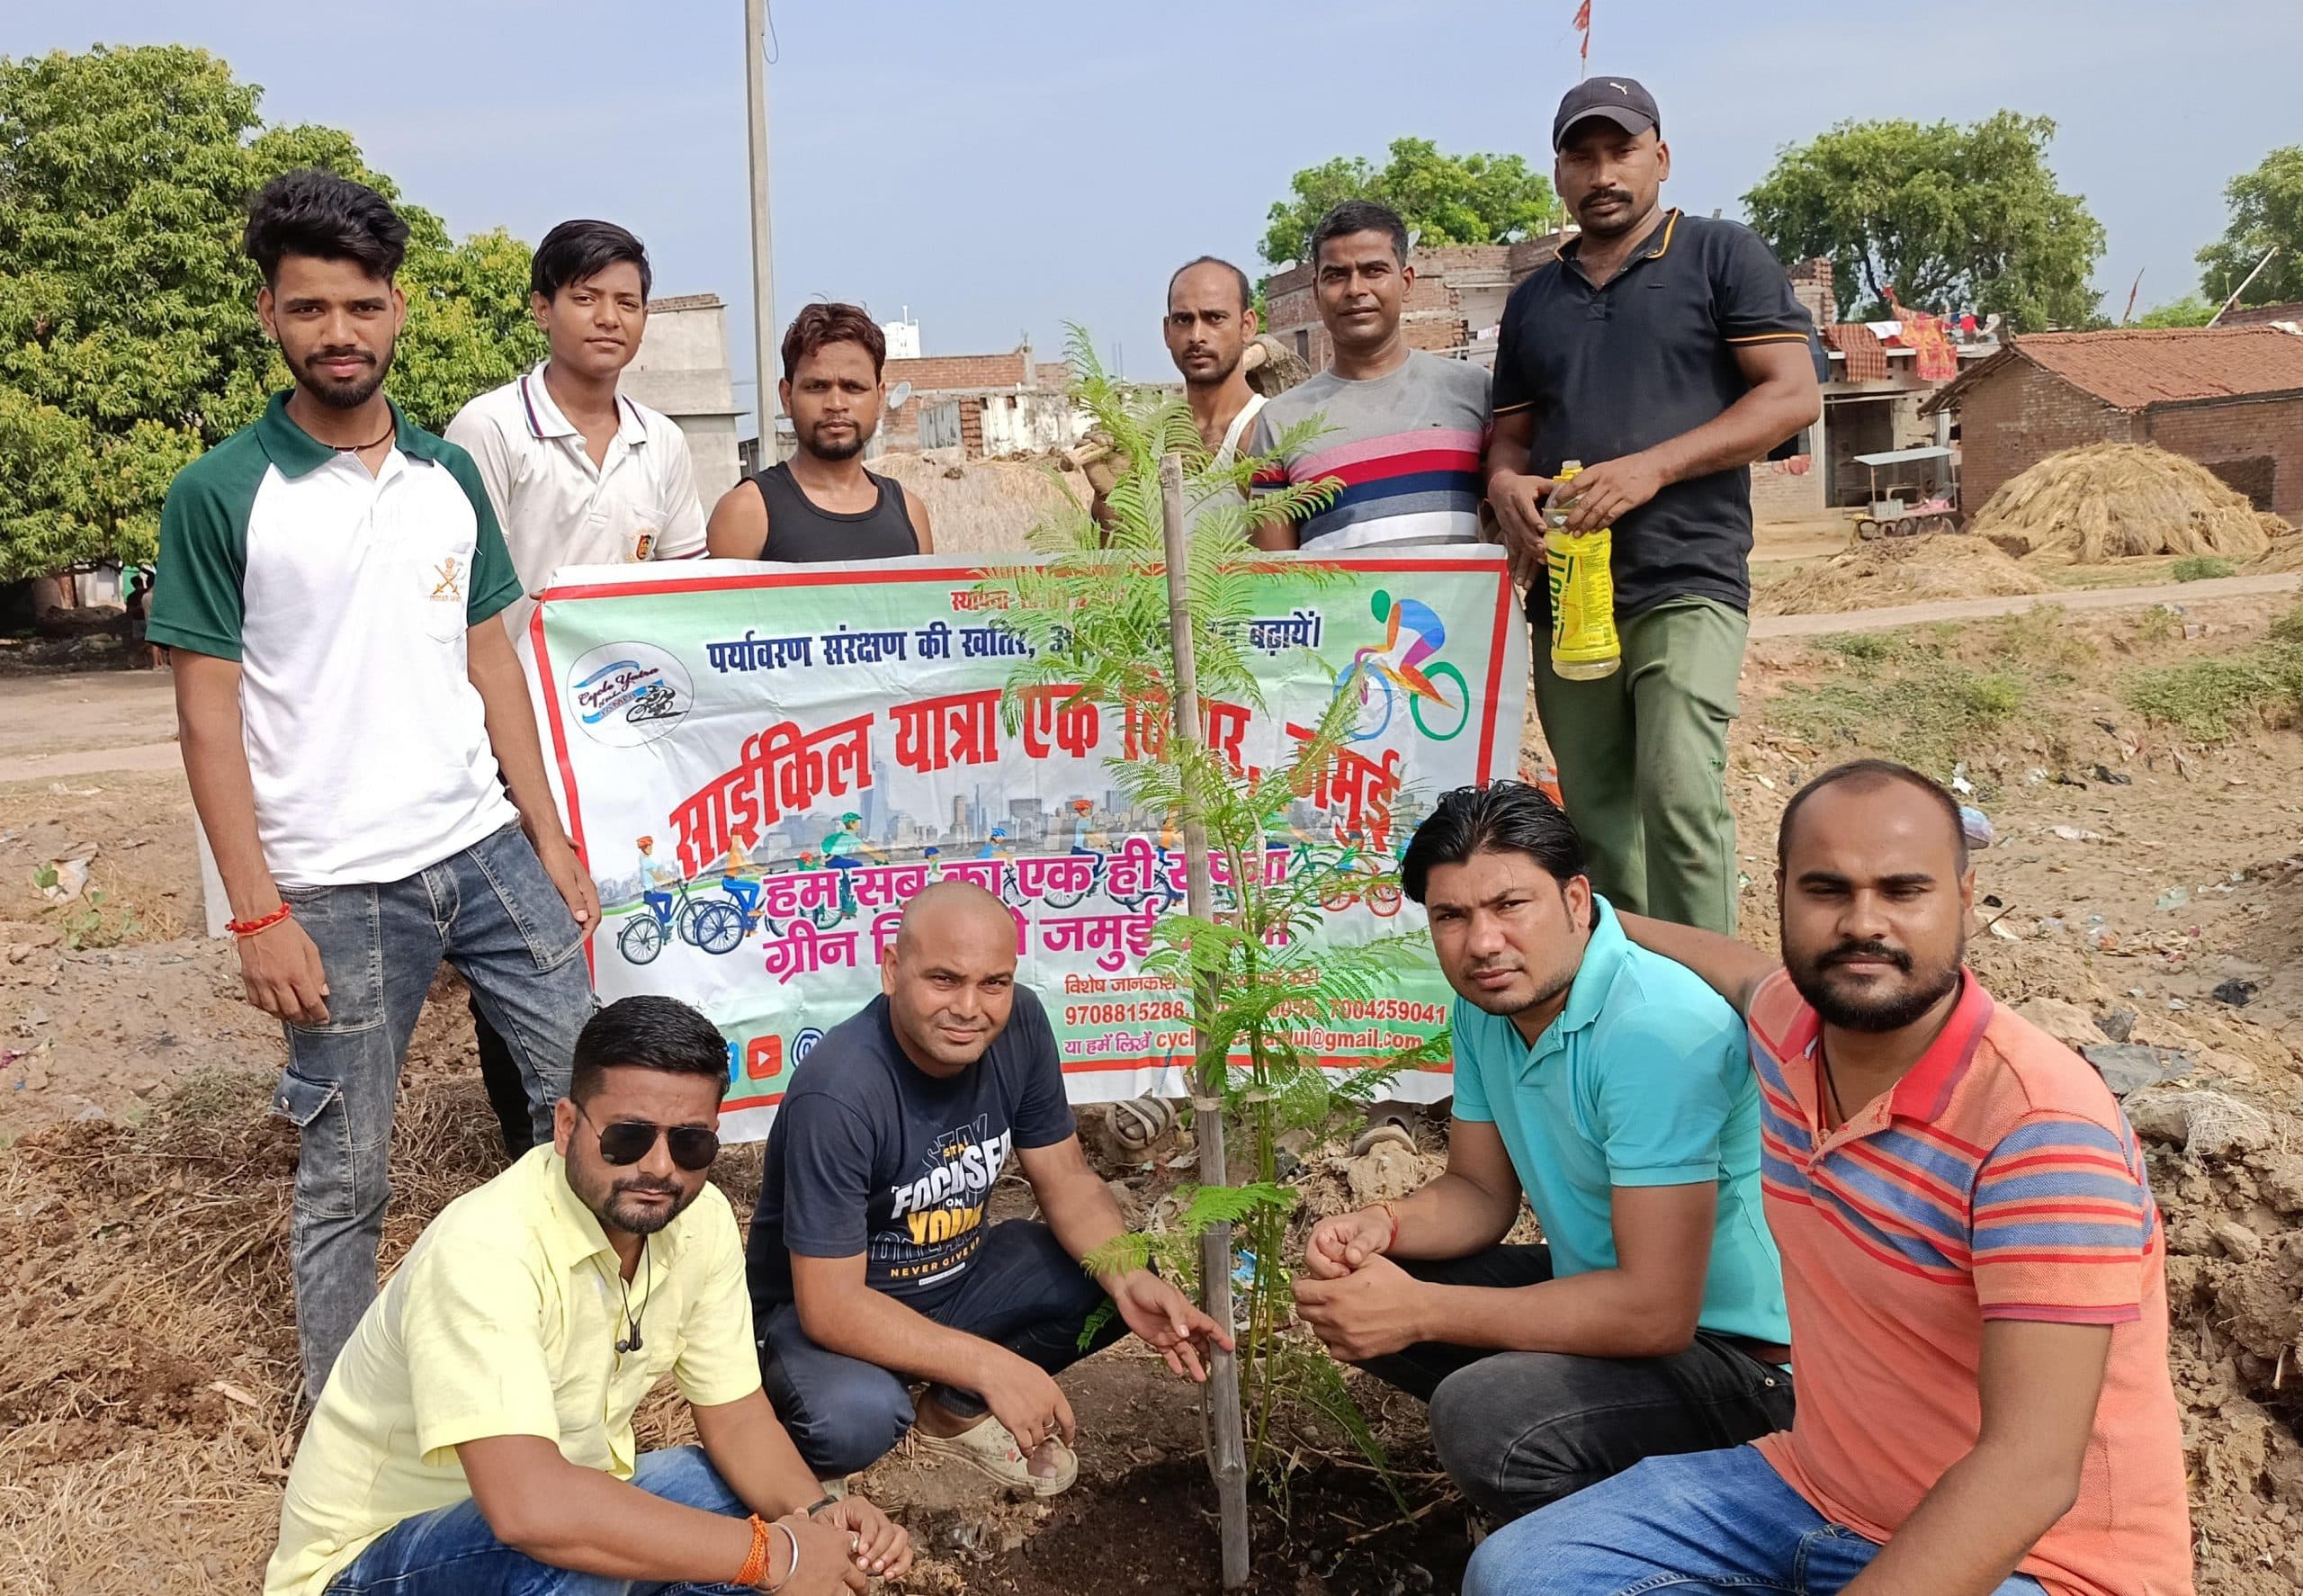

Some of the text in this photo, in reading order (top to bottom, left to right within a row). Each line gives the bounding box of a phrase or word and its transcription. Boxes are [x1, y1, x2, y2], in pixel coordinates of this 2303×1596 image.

[706, 631, 812, 673] पर्यावरण
[820, 625, 907, 665] संरक्षण
[916, 621, 952, 659] की
[669, 713, 874, 878] साईकिल
[889, 689, 1002, 774] यात्रा
[1017, 684, 1105, 758] एक
[764, 871, 840, 918] हम
[852, 865, 928, 901] सब
[1017, 857, 1095, 897] एक
[1107, 838, 1156, 895] ही
[763, 919, 858, 984] ग्रीन
[1040, 900, 1159, 972] जमुई
[1065, 973, 1106, 994] विशेष
[1064, 1040, 1081, 1054] या
[1087, 1034, 1113, 1054] हमें
[1116, 1031, 1152, 1053] लिखें
[943, 1142, 970, 1158] STA
[945, 1198, 963, 1206] ON
[890, 1261, 938, 1277] NEVER
[942, 1246, 969, 1266] GIVE
[970, 1236, 981, 1250] UP
